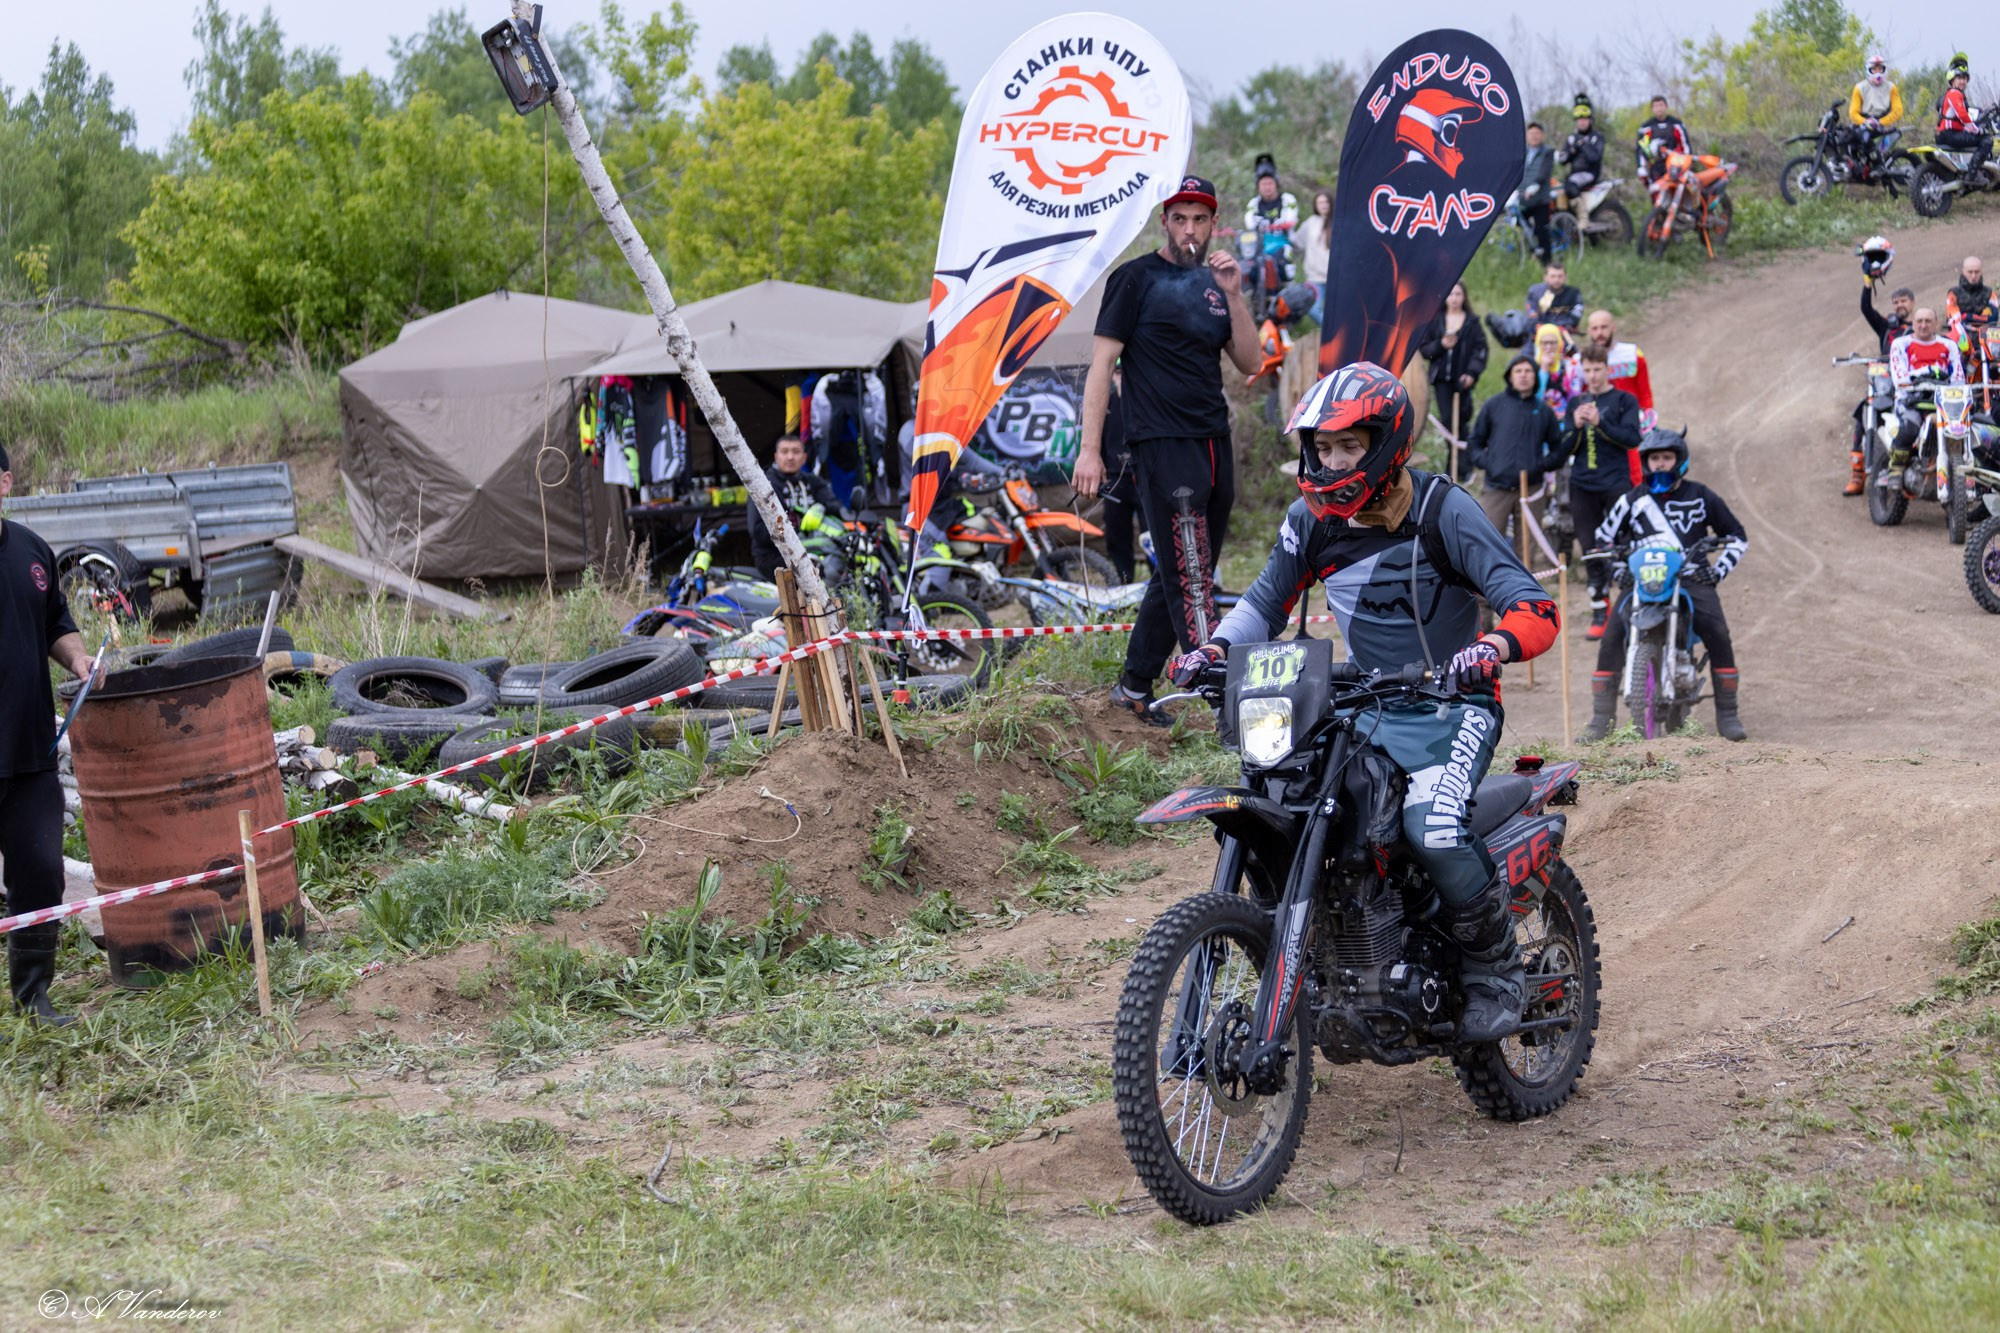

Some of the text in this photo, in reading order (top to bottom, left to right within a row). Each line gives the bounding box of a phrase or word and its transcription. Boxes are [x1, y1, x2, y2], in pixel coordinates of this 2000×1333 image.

[1003, 37, 1151, 100] СТАНКИ ЧПУ
[1367, 52, 1509, 123] ENDURO
[979, 121, 1170, 152] HYPERCUT
[989, 170, 1150, 218] ДЛЯ РЕЗКИ МЕТАЛЛА
[1259, 657, 1286, 679] 10
[1422, 708, 1488, 849] Alpinestars
[1506, 827, 1551, 887] 66
